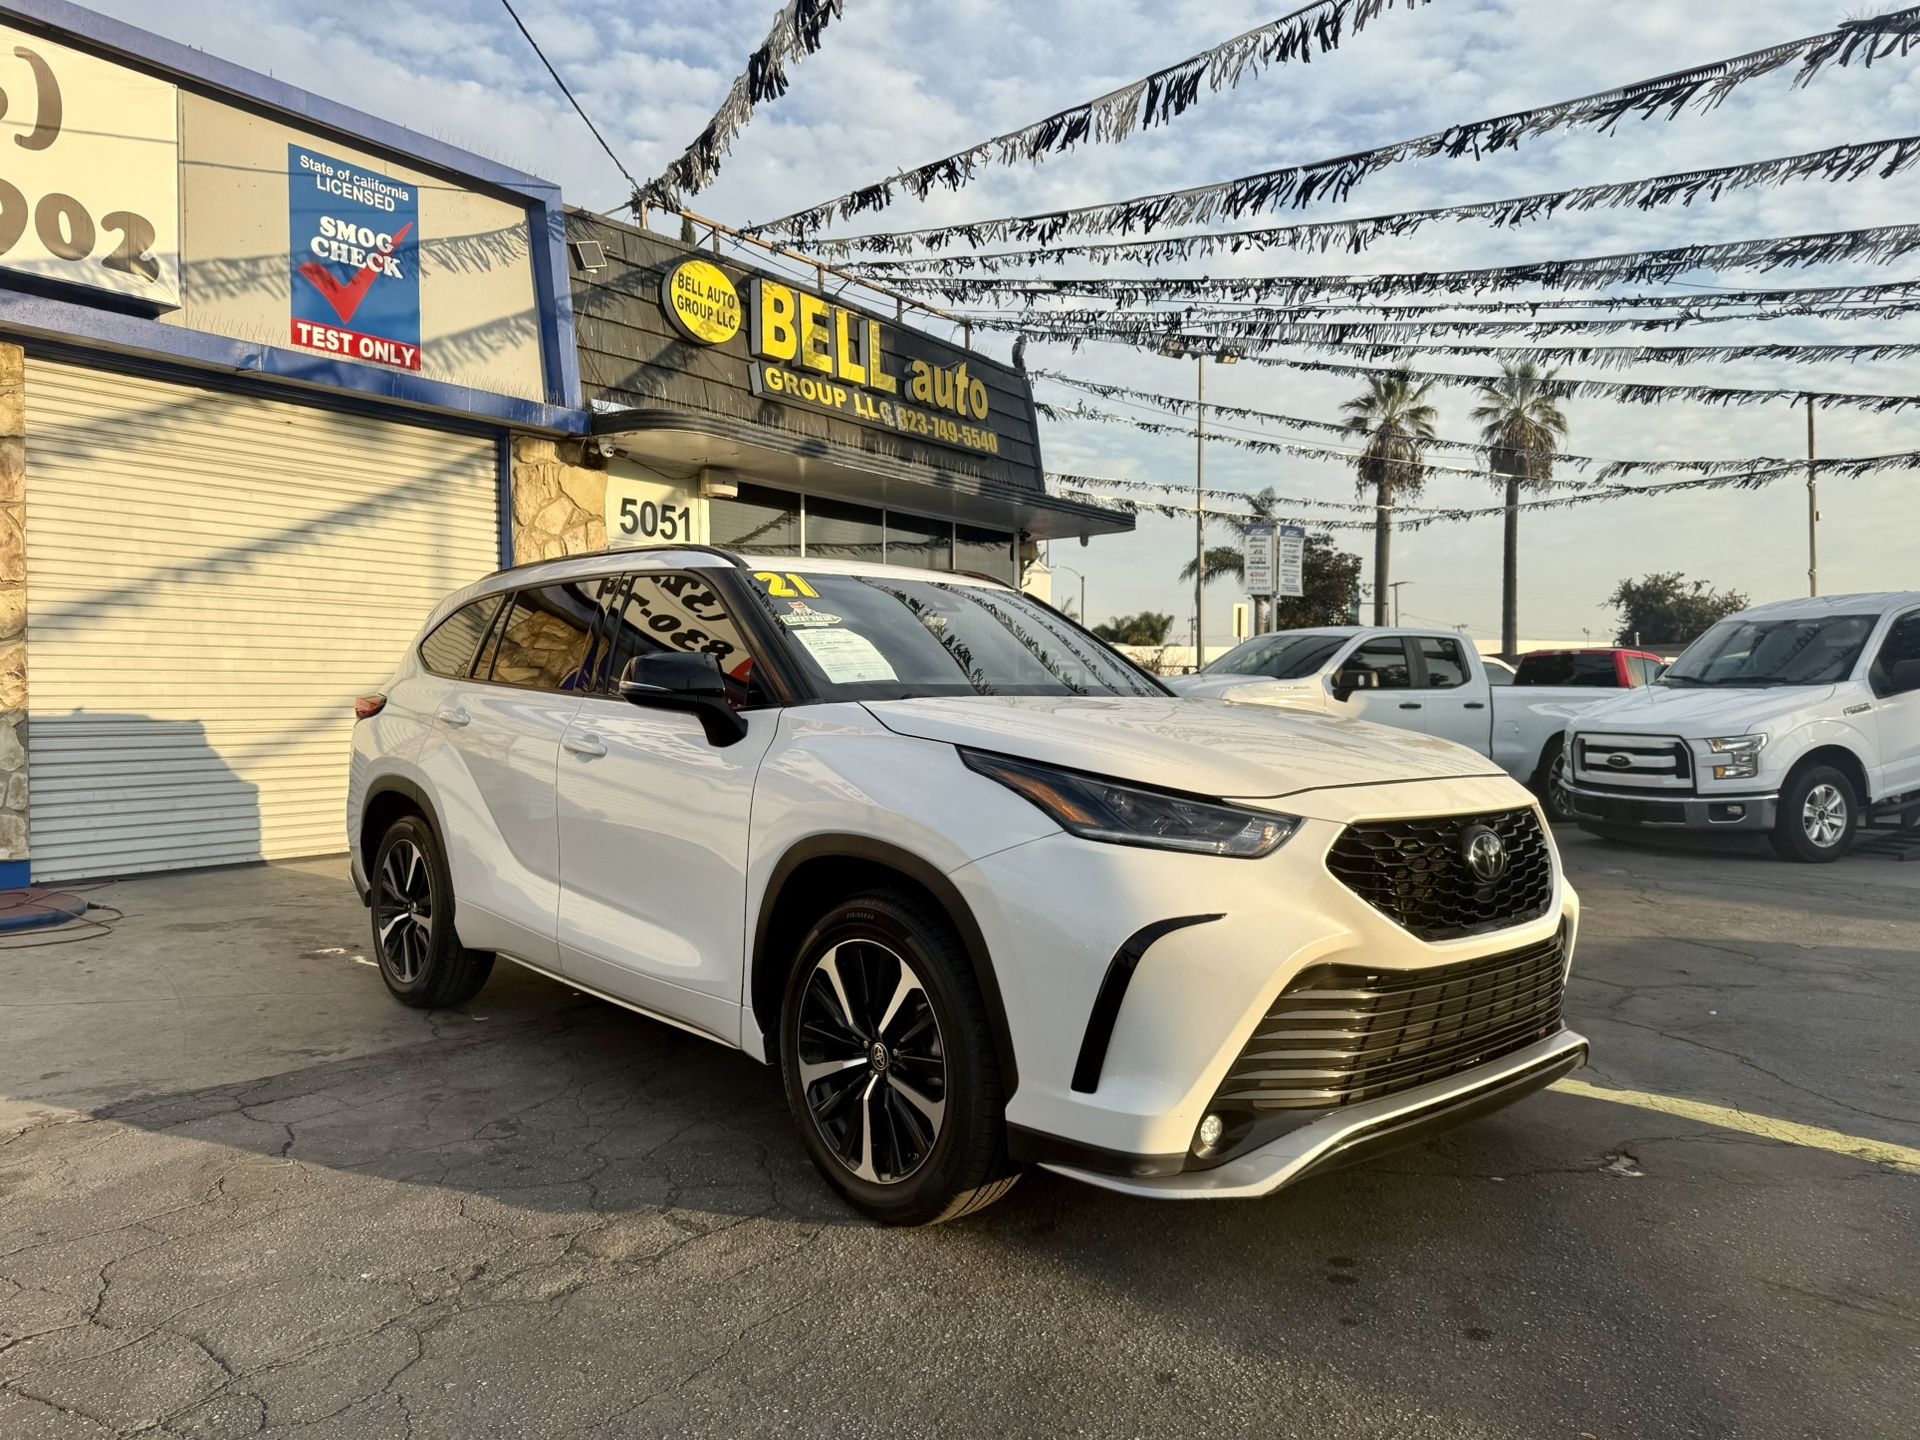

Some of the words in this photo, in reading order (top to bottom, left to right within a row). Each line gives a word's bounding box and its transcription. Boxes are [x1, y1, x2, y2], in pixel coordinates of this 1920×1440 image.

[300, 155, 334, 176] State
[337, 170, 350, 180] of
[353, 175, 409, 201] california
[317, 174, 395, 212] LICENSED
[320, 216, 394, 253] SMOG
[310, 236, 403, 279] CHECK
[677, 272, 704, 298] BELL
[707, 285, 735, 309] AUTO
[676, 294, 713, 321] GROUP
[716, 309, 736, 331] LLC
[297, 322, 353, 353] TEST
[359, 338, 415, 366] ONLY
[761, 277, 897, 394] BELL
[765, 367, 848, 408] GROUP
[911, 360, 990, 421] auto
[619, 497, 691, 542] 5051
[753, 571, 821, 598] 21
